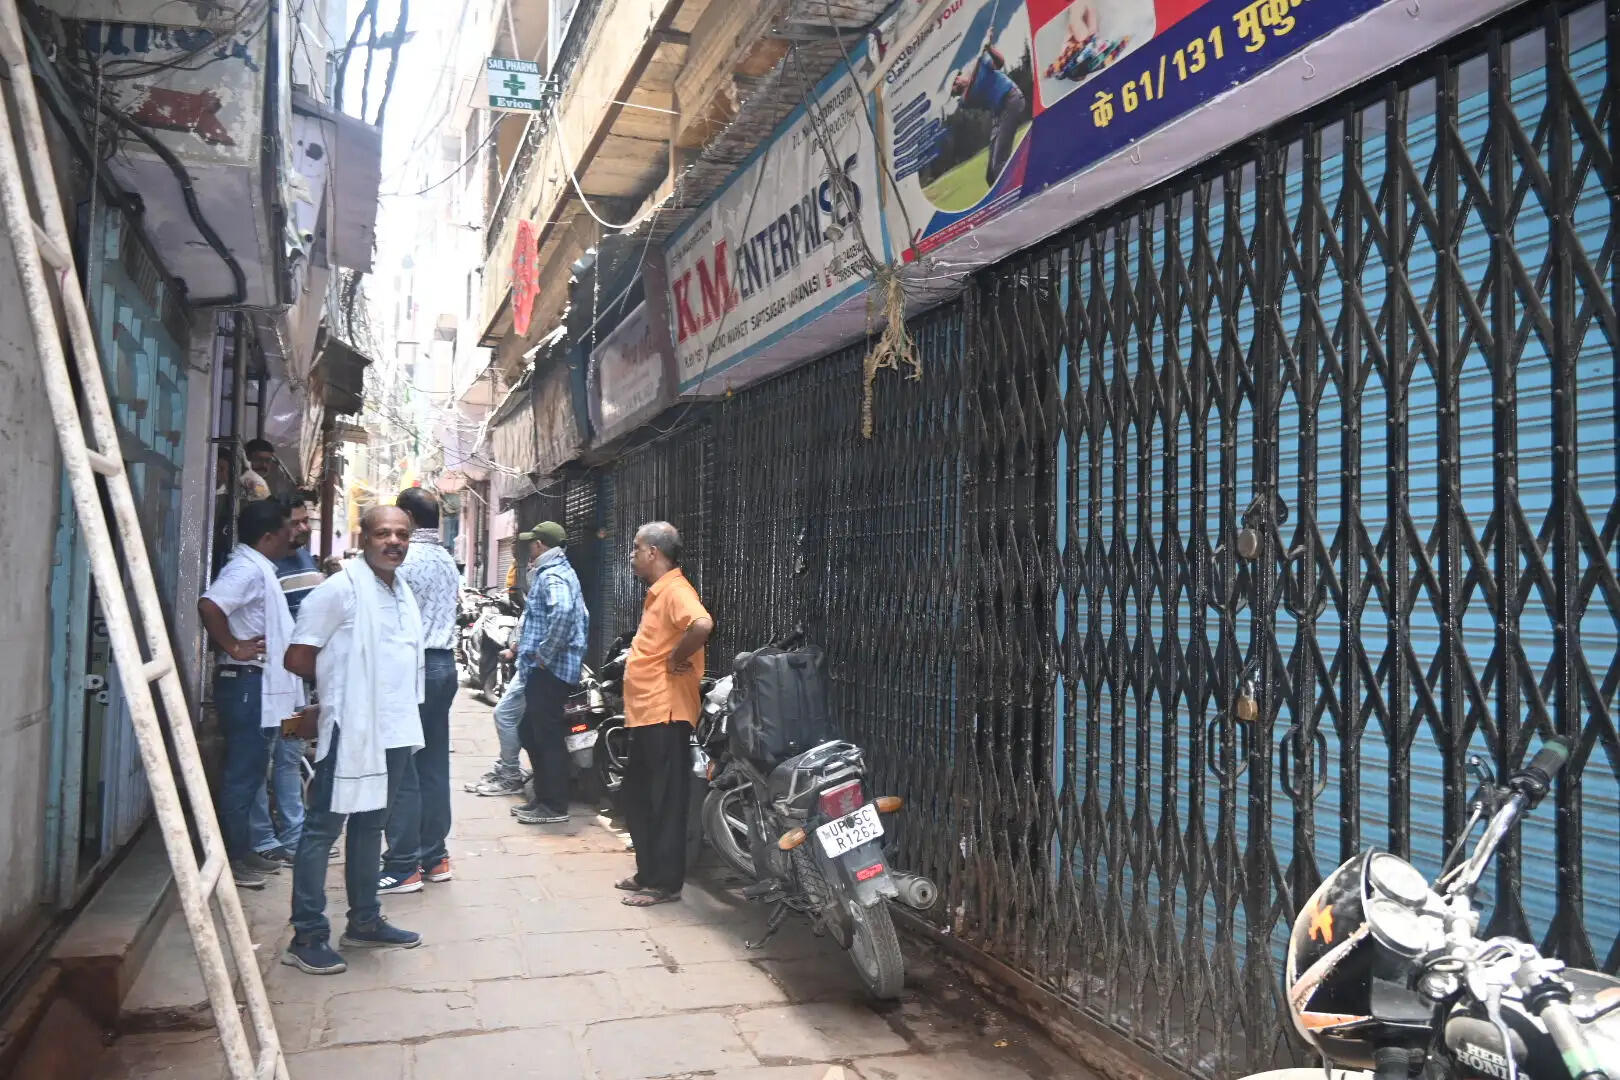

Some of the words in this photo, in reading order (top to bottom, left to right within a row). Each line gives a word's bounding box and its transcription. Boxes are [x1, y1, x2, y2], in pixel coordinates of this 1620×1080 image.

[505, 60, 539, 73] PHARMA
[1089, 90, 1114, 127] के
[1121, 25, 1225, 113] 61/131
[1232, 0, 1304, 52] मुकु
[496, 97, 533, 109] Evion
[829, 809, 872, 837] UP5C
[836, 823, 879, 850] R1262
